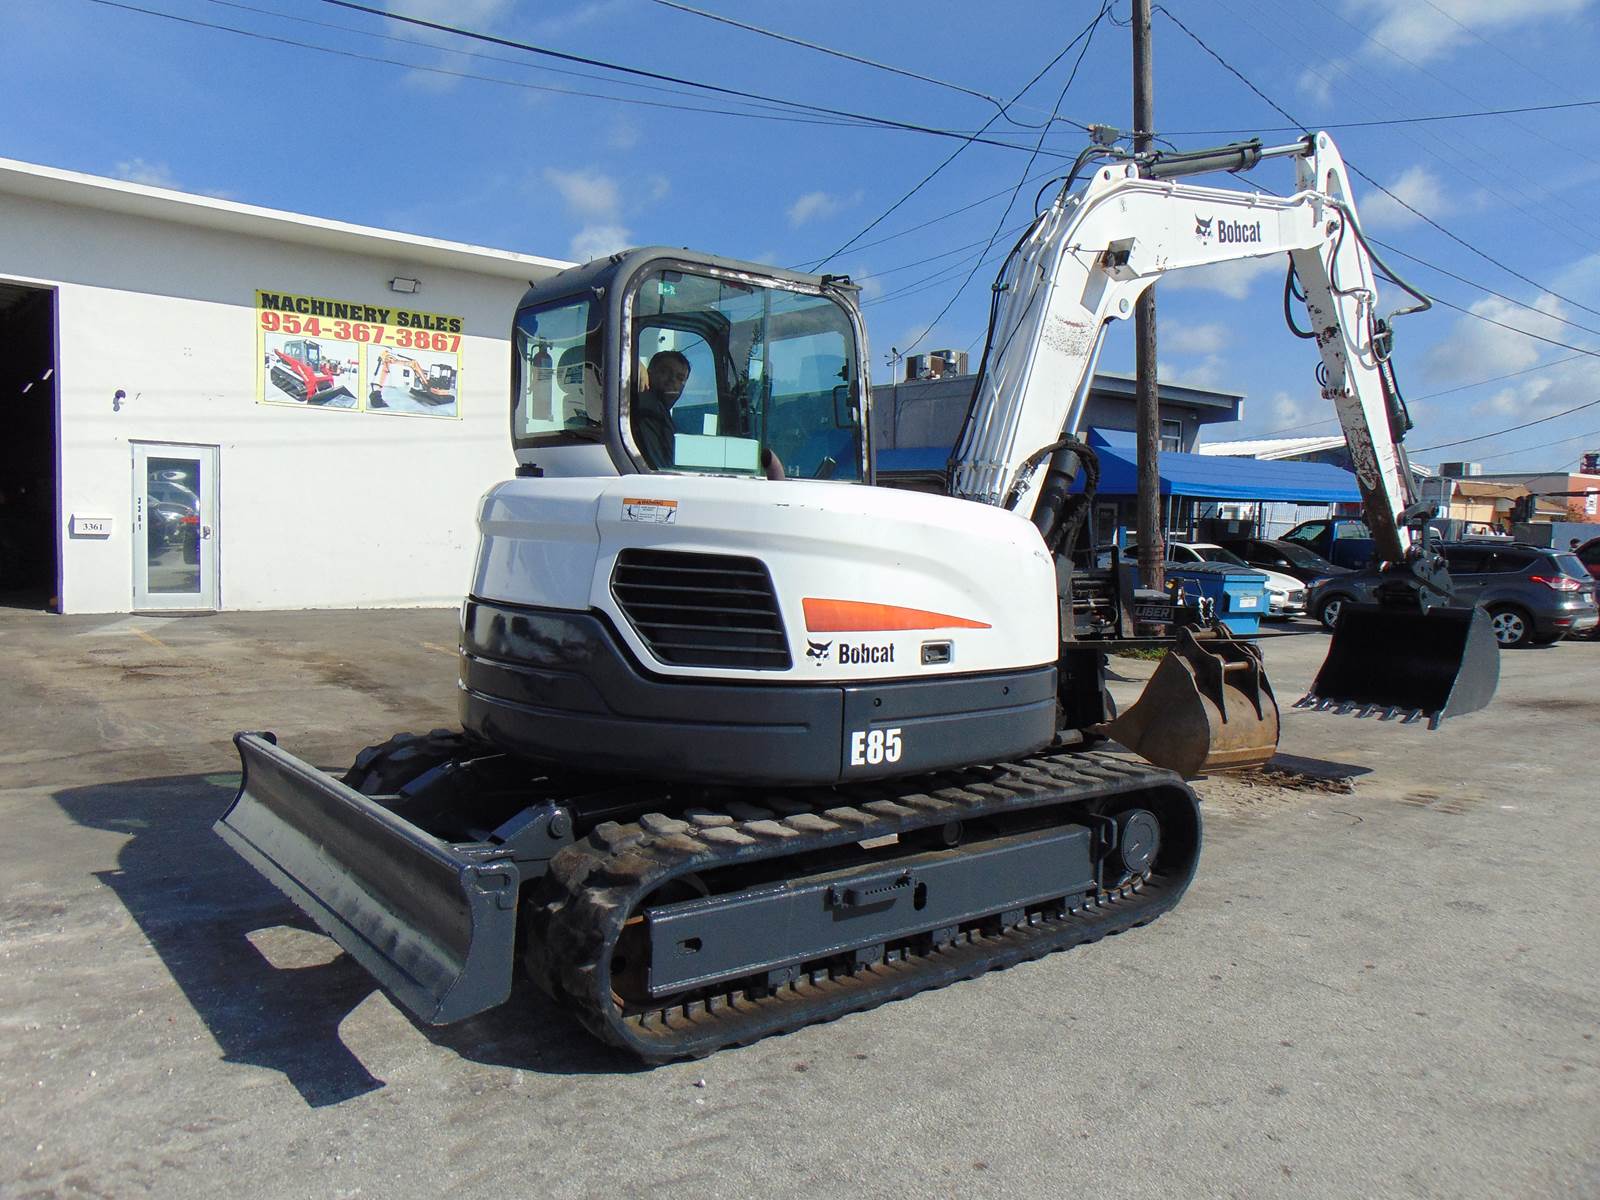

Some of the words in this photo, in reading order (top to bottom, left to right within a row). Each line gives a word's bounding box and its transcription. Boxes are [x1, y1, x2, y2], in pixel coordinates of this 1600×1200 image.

[1218, 220, 1261, 243] Bobcat
[261, 293, 390, 324] MACHINERY
[397, 311, 461, 333] SALES
[261, 311, 461, 352] 954-367-3867
[83, 523, 103, 531] 3361
[839, 642, 895, 664] Bobcat
[851, 728, 903, 766] E85
